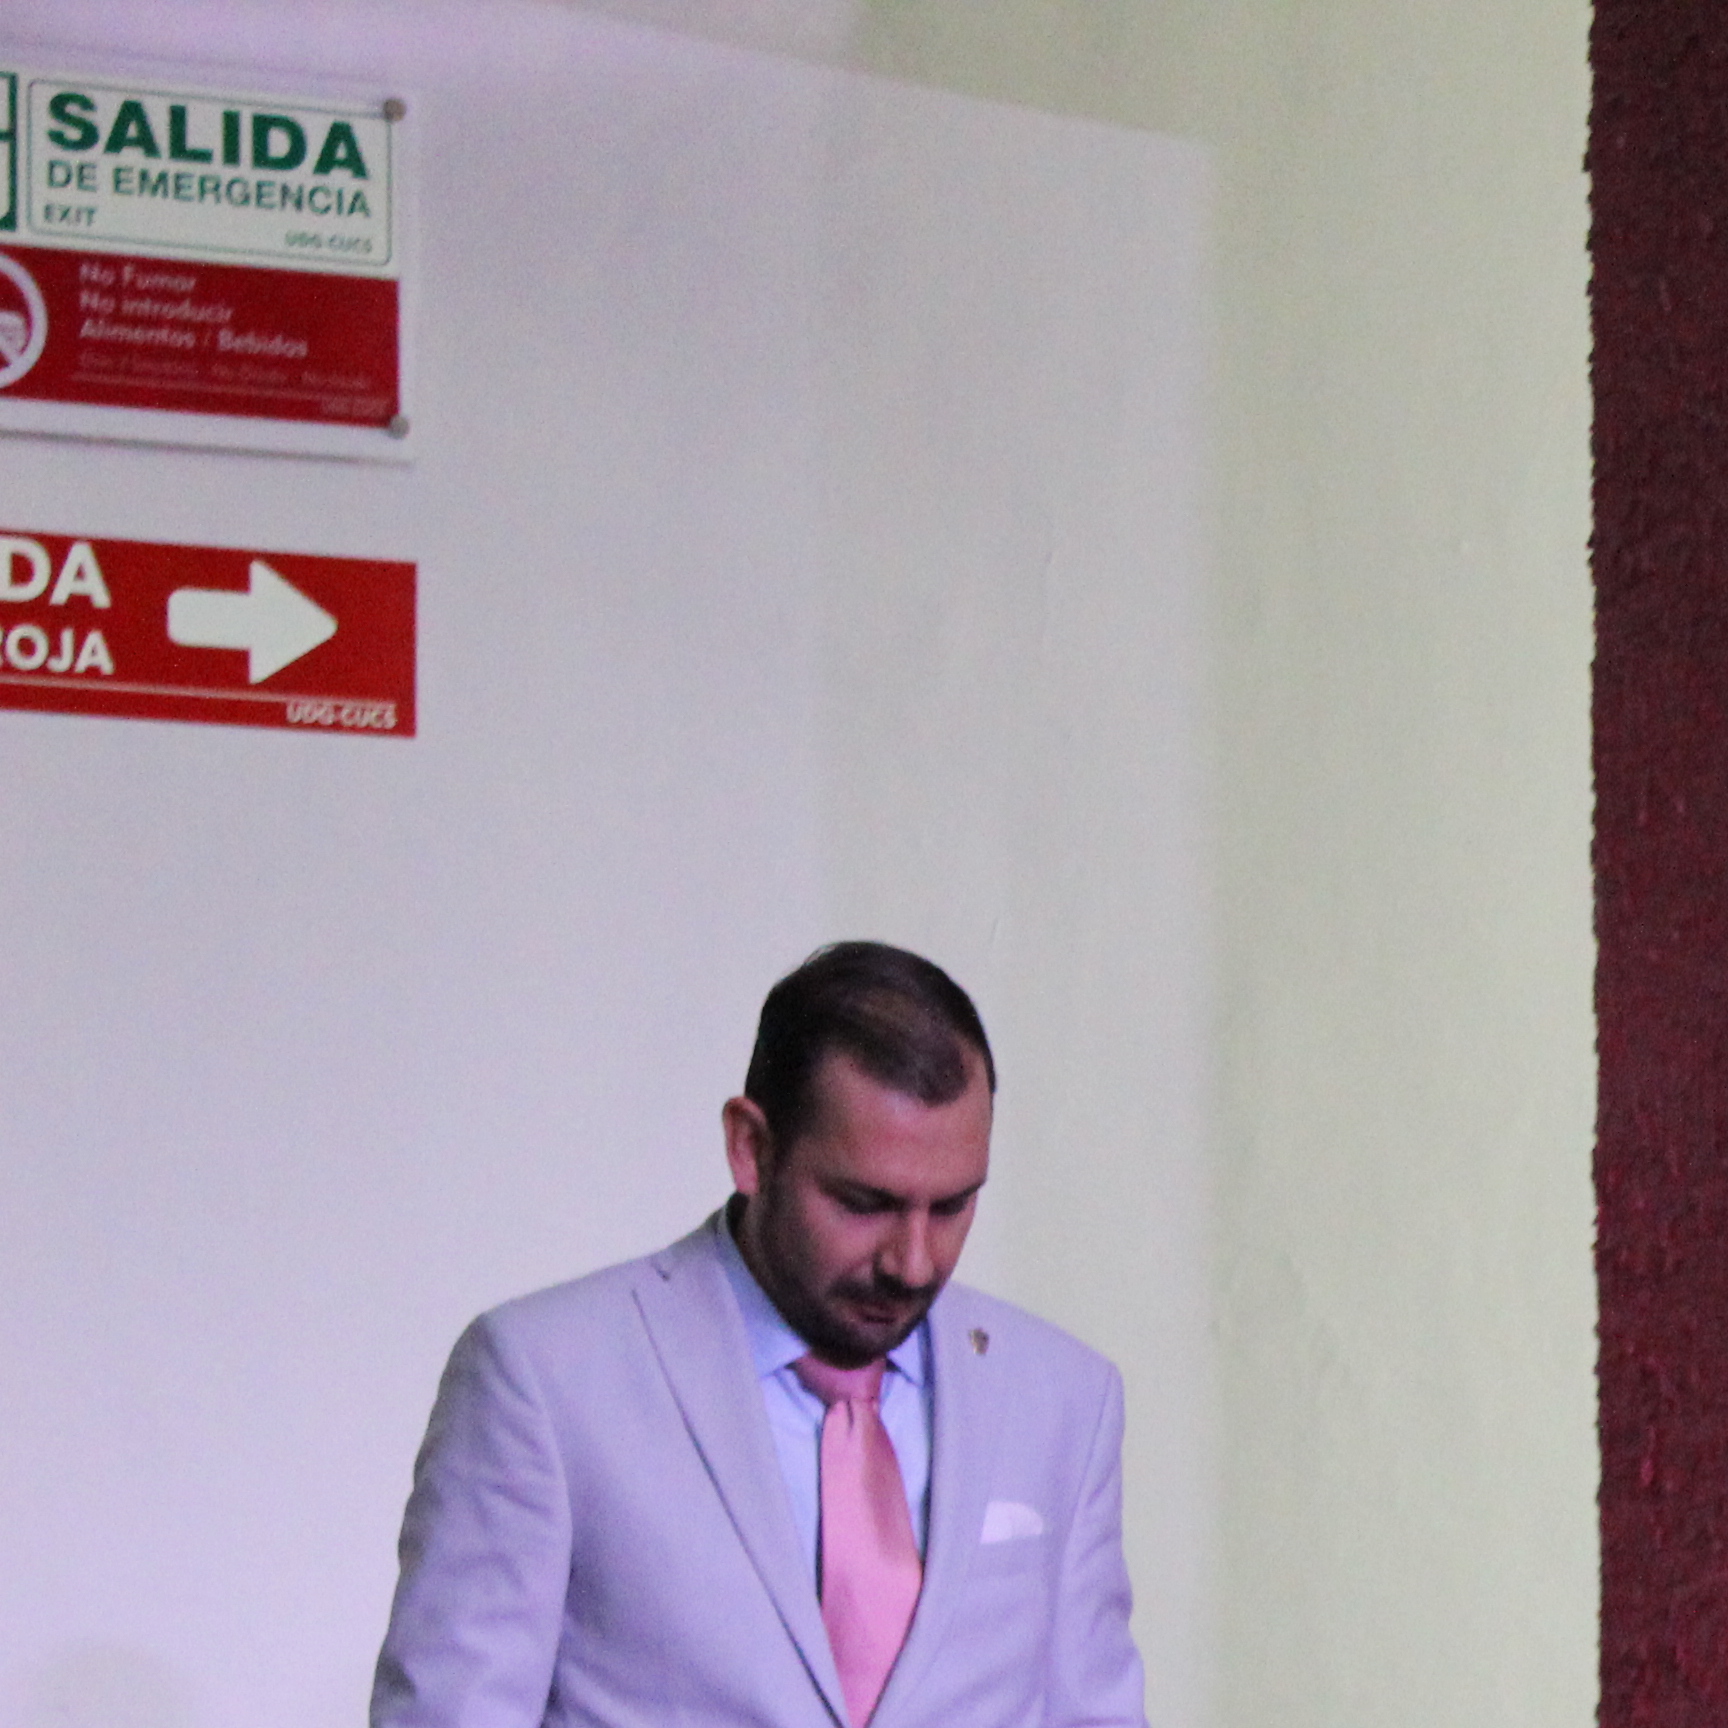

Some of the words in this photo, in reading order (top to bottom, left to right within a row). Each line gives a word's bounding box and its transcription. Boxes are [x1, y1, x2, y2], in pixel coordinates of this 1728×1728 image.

[47, 92, 369, 181] SALIDA
[47, 159, 98, 192] DE
[112, 167, 372, 217] EMERGENCIA
[44, 204, 97, 227] EXIT
[80, 263, 116, 286] No
[121, 264, 196, 291] Fumar
[80, 290, 116, 314] No
[121, 298, 234, 323] introducir
[80, 318, 196, 350] Alimentos
[218, 327, 308, 359] Bebidas
